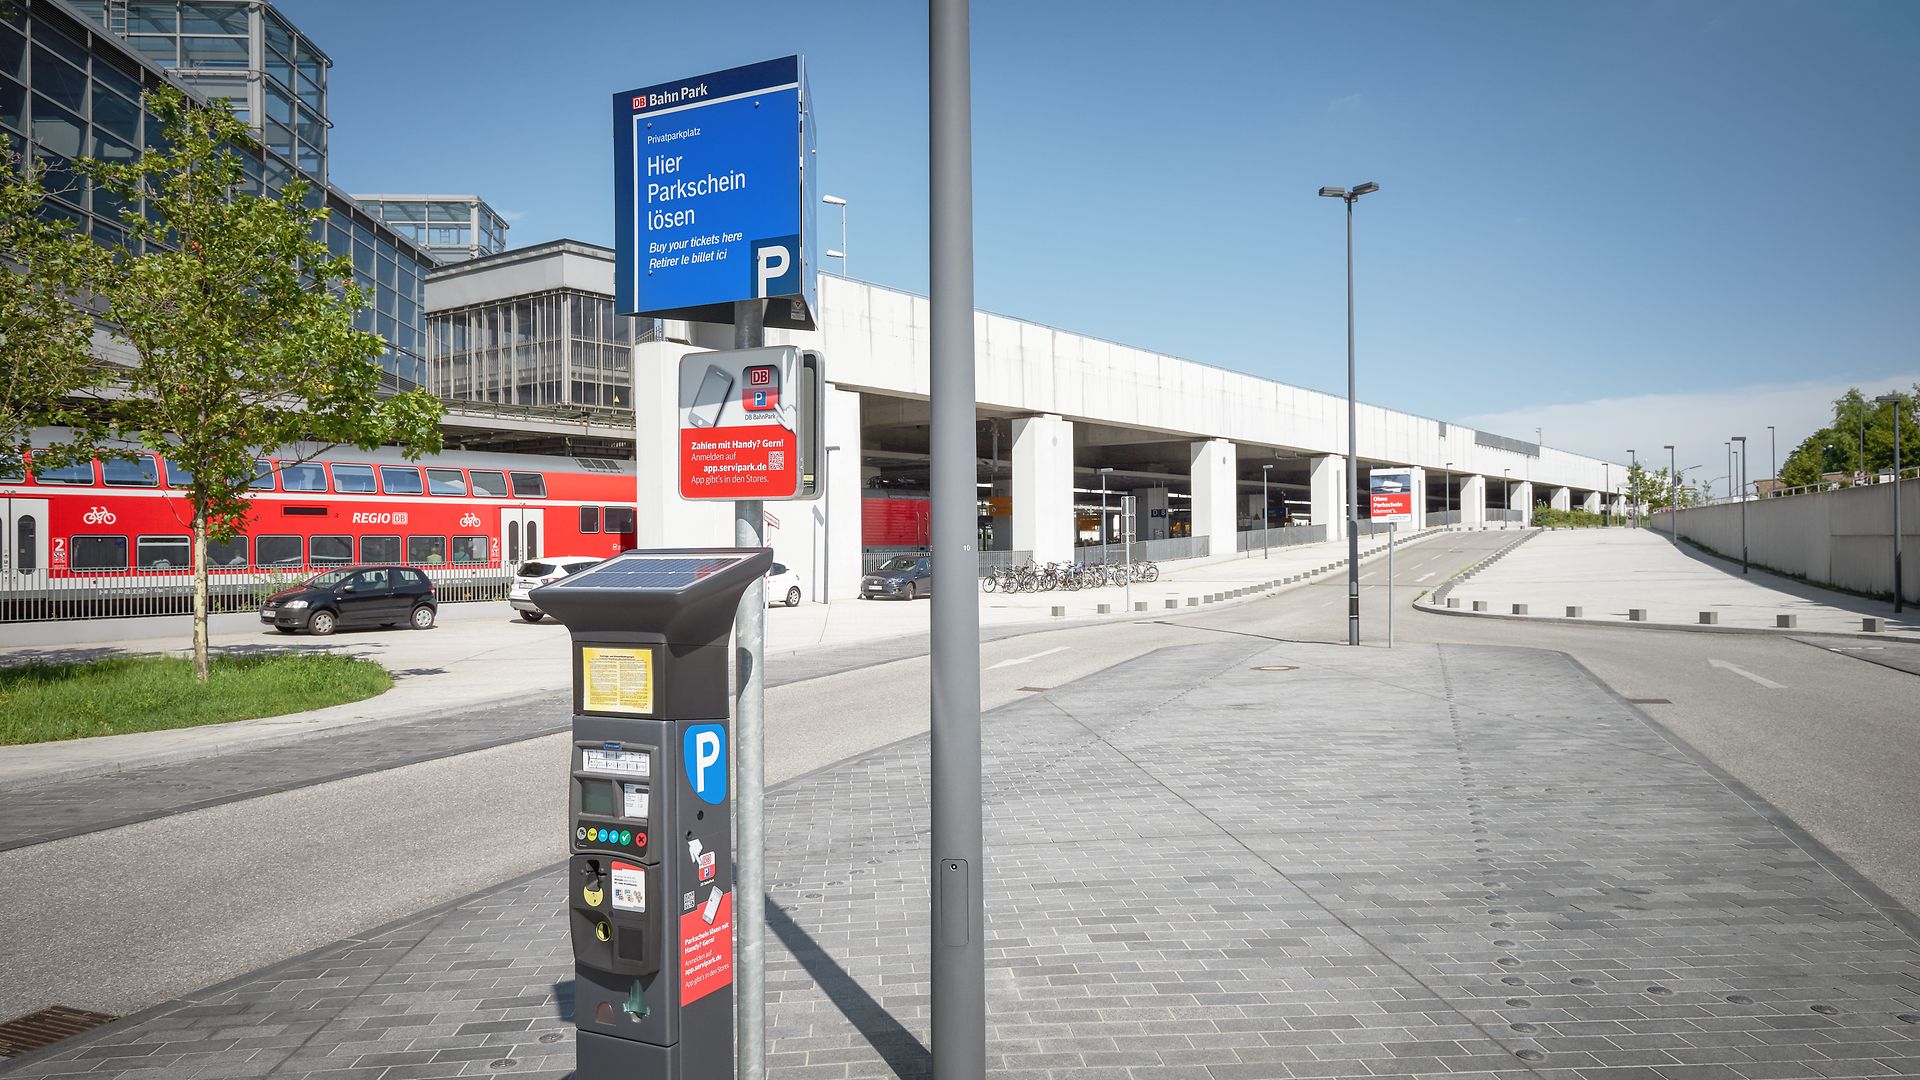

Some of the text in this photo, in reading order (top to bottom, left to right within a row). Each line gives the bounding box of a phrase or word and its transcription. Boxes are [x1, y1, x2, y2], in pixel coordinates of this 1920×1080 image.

[633, 83, 708, 108] DB Bahn Park
[647, 128, 701, 145] Privatparkplatz
[647, 154, 683, 177] Hier
[647, 170, 746, 204] Parkschein
[647, 208, 695, 231] lösen
[649, 231, 743, 254] Buy your tickets here
[649, 248, 728, 269] Retirer le billet ici
[757, 245, 791, 299] P
[752, 370, 768, 384] DB
[755, 392, 763, 406] P
[691, 438, 784, 450] Zahlen mit Handy? Gern!
[691, 451, 737, 461] Anmelden auf
[703, 463, 767, 474] app.servipark.de
[691, 476, 705, 485] App
[724, 475, 731, 483] in
[732, 475, 745, 483] den
[746, 474, 769, 483] Stores.
[352, 512, 407, 524] REGIO DB
[55, 539, 65, 551] 2
[492, 538, 498, 548] 2
[696, 731, 720, 793] P
